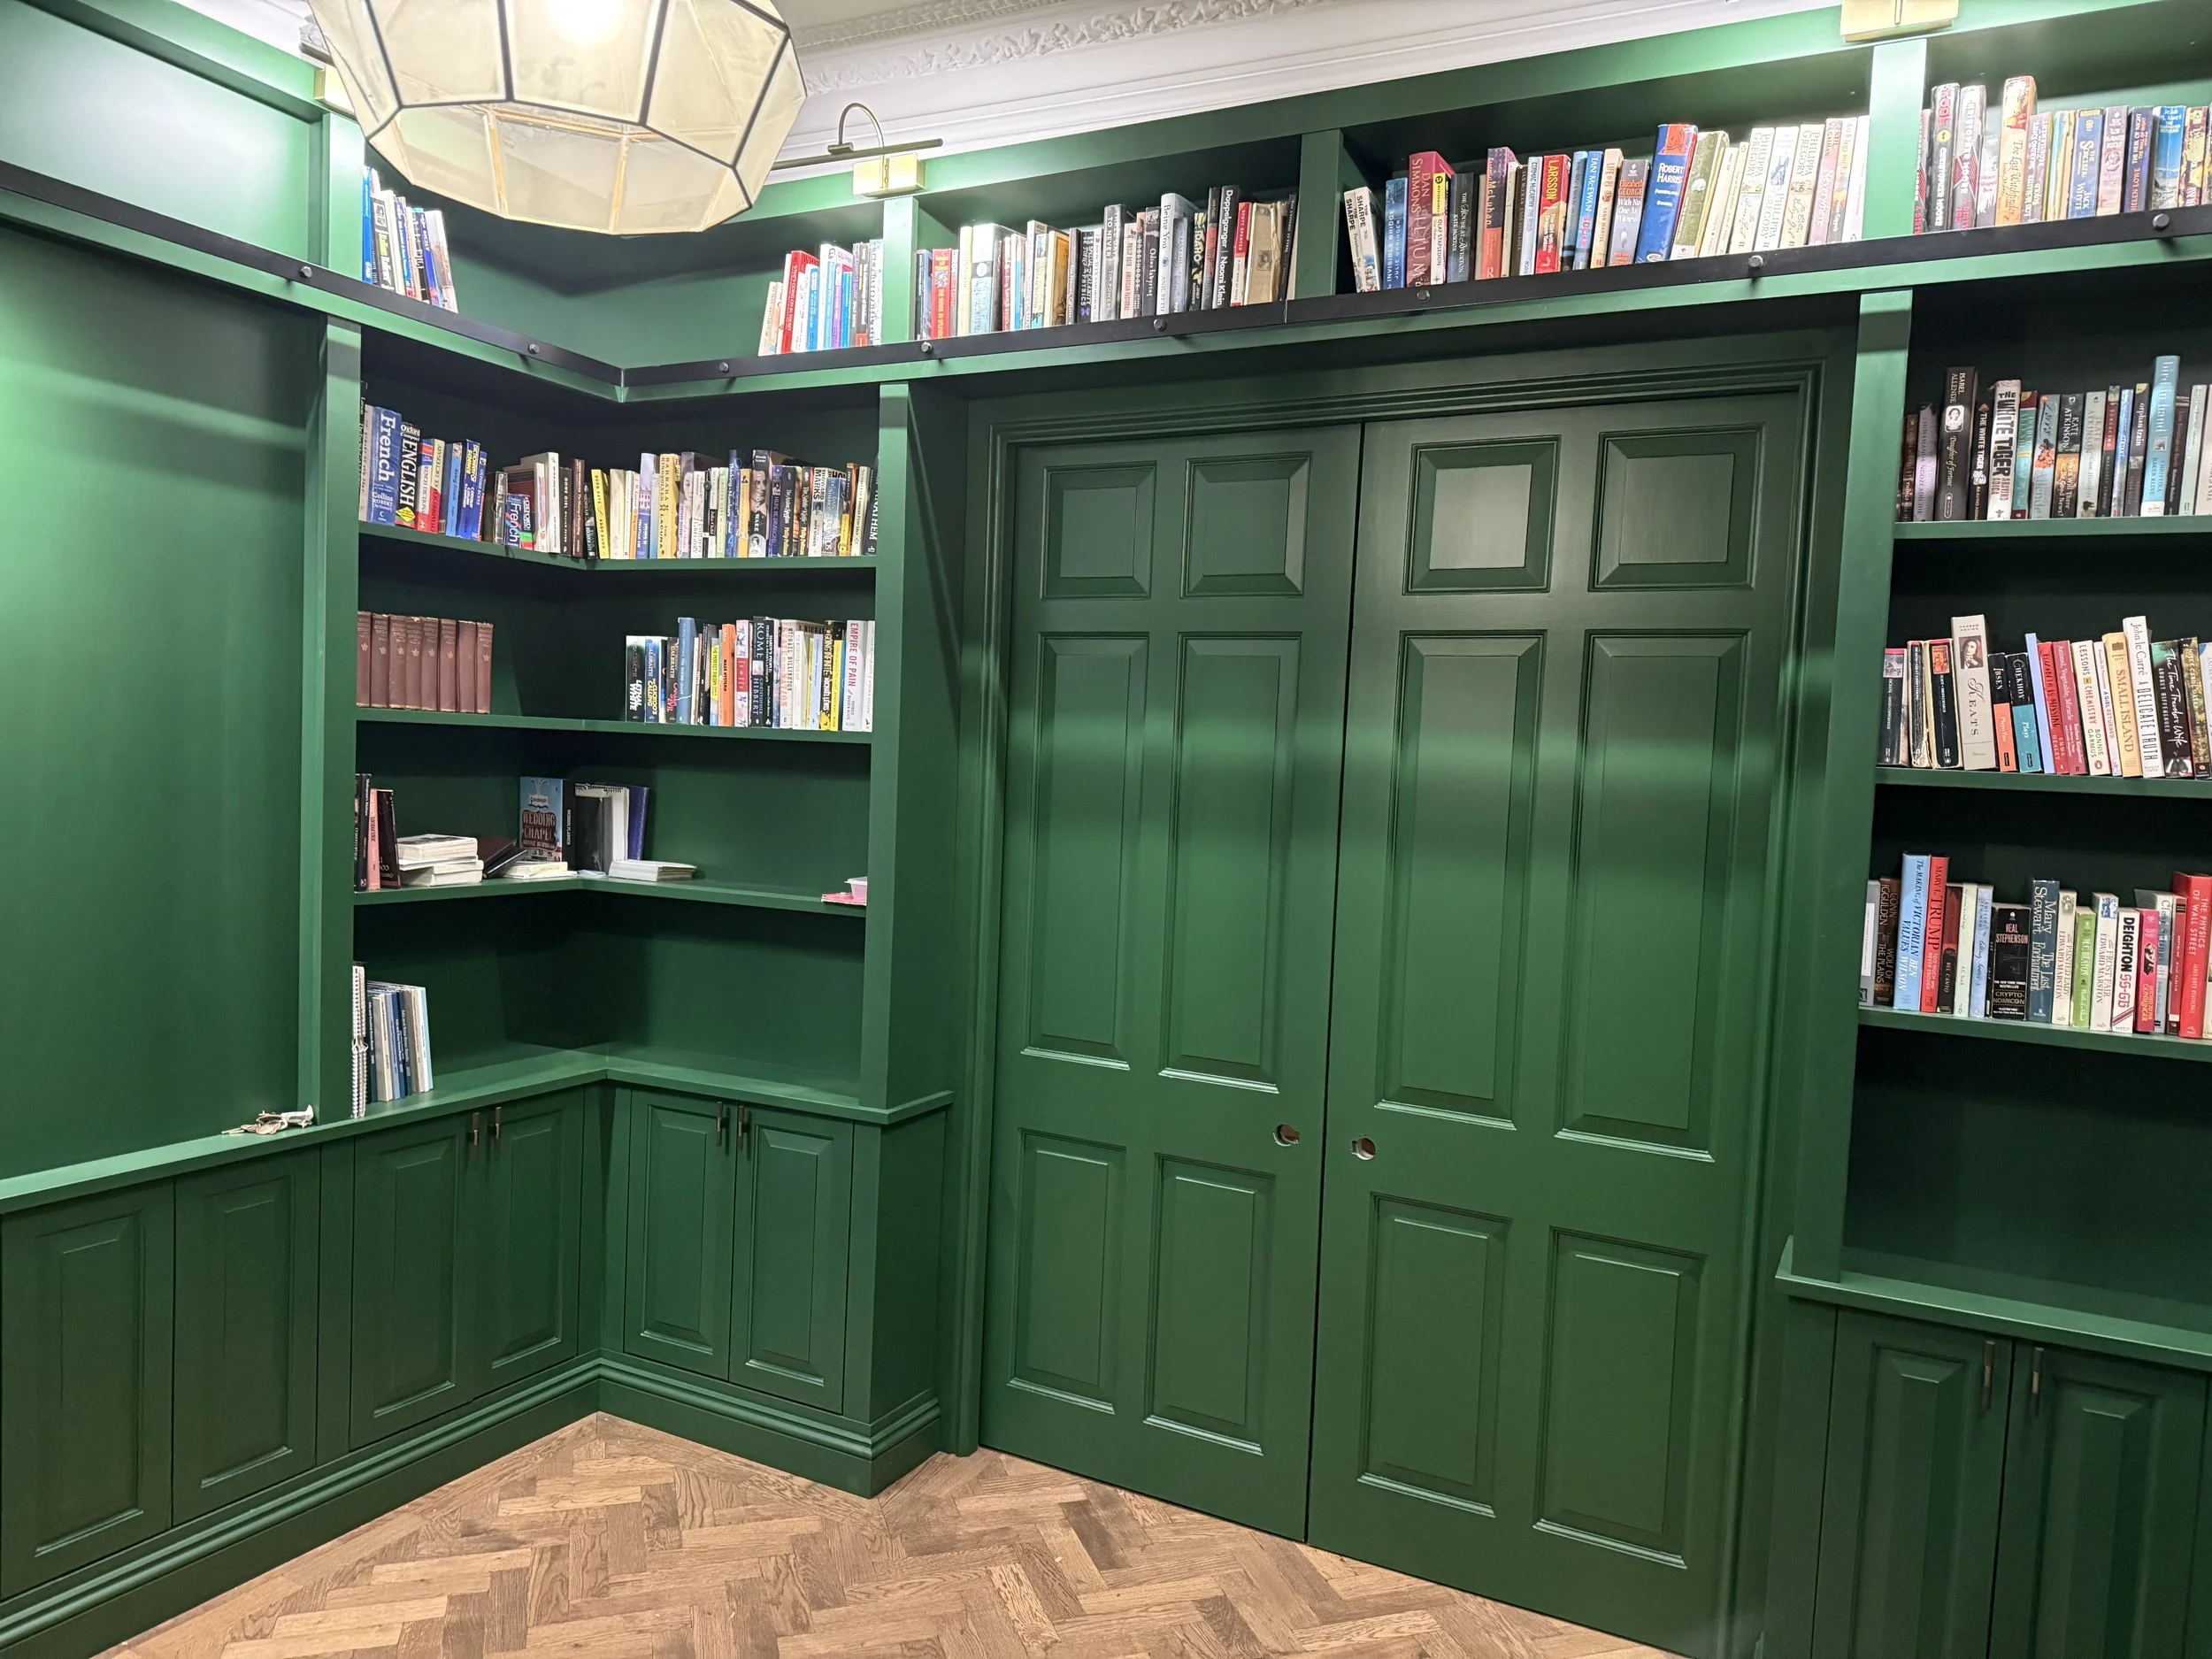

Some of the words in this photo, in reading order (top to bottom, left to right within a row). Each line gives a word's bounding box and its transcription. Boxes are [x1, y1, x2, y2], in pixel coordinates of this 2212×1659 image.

[1796, 130, 1812, 177] GREGORY
[1804, 131, 1821, 176] PHILIPPA
[1824, 132, 1833, 157] GAIMAN
[1589, 157, 1599, 173] IAN
[1656, 173, 1682, 184] HARRIS
[1658, 162, 1685, 174] ROBERT
[1410, 158, 1423, 213] SIMMONS
[1421, 173, 1431, 197] DAN
[1546, 159, 1559, 200] LARSSON
[1618, 188, 1643, 196] GEORGE
[1585, 175, 1596, 212] McEWAN
[1817, 170, 1834, 227] Neverwhere
[2075, 182, 2086, 211] WHYTE
[2083, 191, 2092, 209] JACK
[1108, 217, 1113, 227] TO
[1163, 204, 1171, 231] Being
[1221, 189, 1233, 249] Doppelganger
[1346, 198, 1356, 230] SHARPE
[1356, 196, 1365, 227] SHARPE
[1194, 230, 1203, 262] IDAHO
[1412, 217, 1428, 276] ILIUM
[1458, 238, 1468, 273] RIVERTON
[1218, 256, 1228, 283] Naomi
[1217, 285, 1225, 306] Klein
[2162, 361, 2174, 386] bird
[2160, 389, 2171, 401] in
[400, 424, 420, 436] Oxford
[1996, 399, 2016, 435] WHITE
[2043, 402, 2056, 436] Zorro
[2062, 408, 2072, 449] ATKINSON
[2070, 417, 2079, 436] KATE
[2155, 404, 2170, 433] hand
[378, 413, 396, 481] French
[1947, 435, 1957, 459] Daughter
[1978, 427, 1986, 449] WHITE
[2135, 429, 2144, 447] train
[1993, 437, 2013, 477] TIGER
[399, 438, 418, 507] ENGLISH
[813, 469, 822, 500] MARKS
[2061, 471, 2067, 480] Be
[1991, 478, 2001, 495] ADIGA
[2000, 478, 2011, 501] ARAVIND
[509, 503, 522, 542] French
[824, 634, 833, 651] GOING
[849, 623, 859, 653] EMPIRE
[2131, 623, 2142, 641] John
[849, 656, 857, 665] OF
[2078, 645, 2090, 676] LESSONS
[2136, 650, 2147, 676] Carré
[2165, 649, 2178, 670] The
[823, 677, 832, 697] MICHAEL
[848, 668, 857, 687] PAIN
[1993, 668, 2004, 690] IBSEN
[2012, 659, 2026, 699] CHEKHOV
[2116, 669, 2129, 709] SMALL
[2168, 671, 2179, 691] Time
[1968, 678, 1984, 736] KEATS
[2085, 686, 2096, 725] CHEMISTRY
[2137, 688, 2155, 729] DELICATE
[2087, 728, 2097, 758] GARMUS
[2094, 729, 2104, 757] BONNIE
[2120, 710, 2134, 752] ISLAND
[2167, 725, 2188, 748] Wife
[2141, 733, 2159, 760] TRUTH
[1916, 859, 1924, 871] The
[1934, 864, 1943, 887] MARY
[1913, 871, 1924, 898] MAKING
[2193, 889, 2201, 900] OF
[1879, 884, 1890, 926] IGGULDEN
[1888, 892, 1898, 918] CONN
[2032, 887, 2047, 934] Stewart
[2042, 901, 2056, 934] Mary
[2190, 904, 2200, 925] WALL
[2200, 897, 2208, 911] THE
[1901, 919, 1911, 953] VALUES
[1909, 905, 1923, 956] VICTORIAN
[1928, 895, 1943, 950] TRUMP
[2005, 923, 2018, 933] NEAL
[2198, 915, 2208, 949] PHYSICS
[1878, 943, 1886, 957] THE
[1995, 933, 2028, 944] STEPHENSON
[2056, 931, 2065, 963] EDWARD
[2120, 917, 2136, 972] DEIGHTON
[2187, 928, 2198, 955] STREET
[1876, 957, 1886, 983] PLAINS
[1885, 949, 1894, 969] WOLF
[1909, 958, 1918, 978] BEN
[2031, 941, 2046, 991] Enchantment
[2041, 952, 2055, 967] The
[2079, 952, 2089, 976] BEATON
[2104, 950, 2114, 977] FROST
[1884, 970, 1893, 979] OF
[1898, 956, 1909, 991] WILSON
[2039, 972, 2053, 990] Last
[2055, 964, 2063, 1000] MARSTON
[2096, 968, 2105, 1003] MARSTON
[2103, 979, 2112, 997] FAIR
[2117, 973, 2132, 1008] SS-GB
